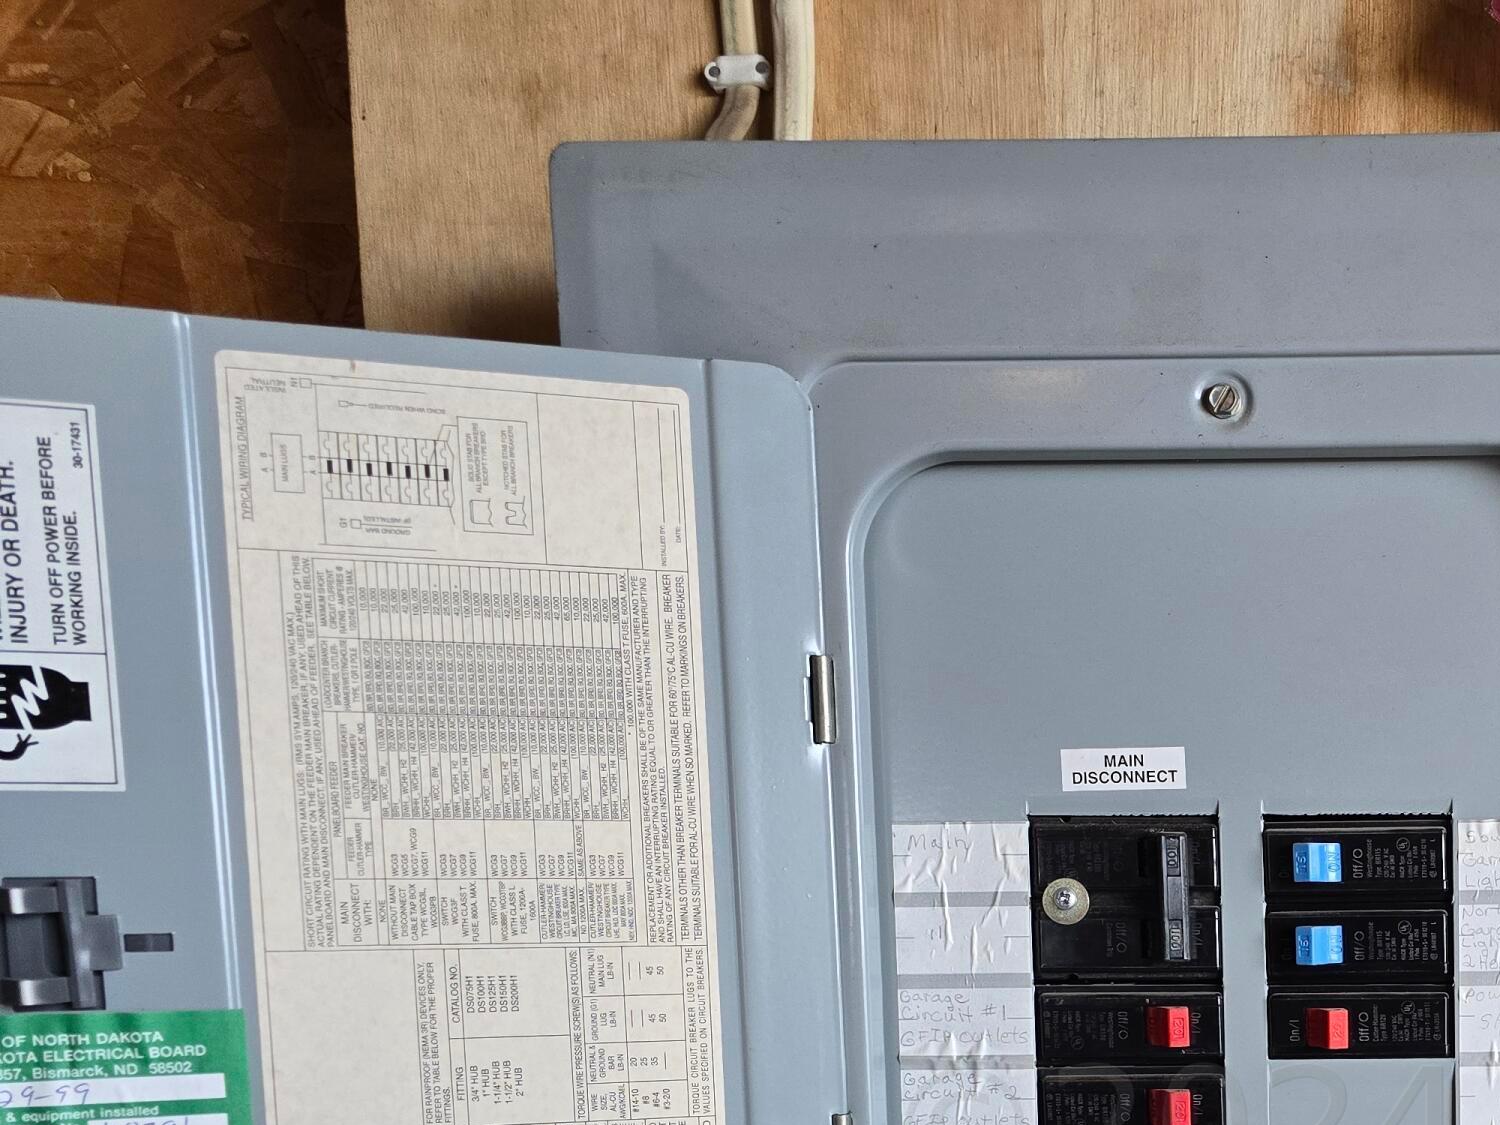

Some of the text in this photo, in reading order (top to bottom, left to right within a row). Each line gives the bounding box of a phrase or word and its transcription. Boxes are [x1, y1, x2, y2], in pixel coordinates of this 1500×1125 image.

[70, 422, 83, 469] 30-17431
[233, 396, 252, 521] TYPICAL WIRING DIAGRAM
[37, 436, 67, 644] TURN OFF POWER BEFORE
[0, 461, 28, 644] INJURY OR DEATH.
[63, 511, 86, 645] WORKING INSIDE.
[1104, 754, 1144, 767] MAIN
[1072, 770, 1178, 784] DISCONNECT
[908, 834, 972, 851] Main
[1328, 852, 1340, 872] ON
[339, 902, 350, 925] MAIN
[348, 883, 363, 943] DISCONNECT
[361, 900, 373, 927] WITH:
[1463, 954, 1473, 967] 2
[645, 966, 654, 976] 45
[655, 966, 664, 976] 50
[448, 964, 461, 1024] CATALOG NO.
[463, 976, 475, 1014] DS075H1
[474, 976, 488, 1014] DS100H1
[486, 976, 498, 1013] DS125H1
[497, 975, 509, 1013] DS150H1
[508, 975, 520, 1013] DS200H1
[900, 991, 970, 1011] Garage
[647, 1014, 656, 1024] 45
[658, 1013, 667, 1023] 50
[901, 1006, 973, 1022] Circuit
[1, 1031, 164, 1046] OF NORTH DAKOTA
[683, 948, 701, 1115] TORQUE CIRCUIT BREAKER LUGS TO THE
[959, 1029, 1029, 1044] outlets
[43, 1048, 143, 1062] ELECTRICAL
[150, 1045, 207, 1057] BOARD
[629, 1057, 638, 1068] 20
[639, 1057, 648, 1067] 25
[650, 1057, 658, 1066] 35
[33, 1067, 108, 1080] Bismarck,
[114, 1064, 138, 1075] ND
[149, 1062, 192, 1074] 58502
[469, 1065, 479, 1085] HUB
[480, 1069, 490, 1089] HUB
[490, 1061, 501, 1080] HUB
[502, 1060, 512, 1080] HUB
[513, 1067, 523, 1087] HUB
[454, 1067, 466, 1102] FITTING
[903, 1073, 981, 1092] Garage
[630, 1089, 640, 1113] #14-10
[651, 1092, 660, 1108] #6-4
[661, 1088, 671, 1110] #3-2/0
[6, 1106, 159, 1123] & equipment installed
